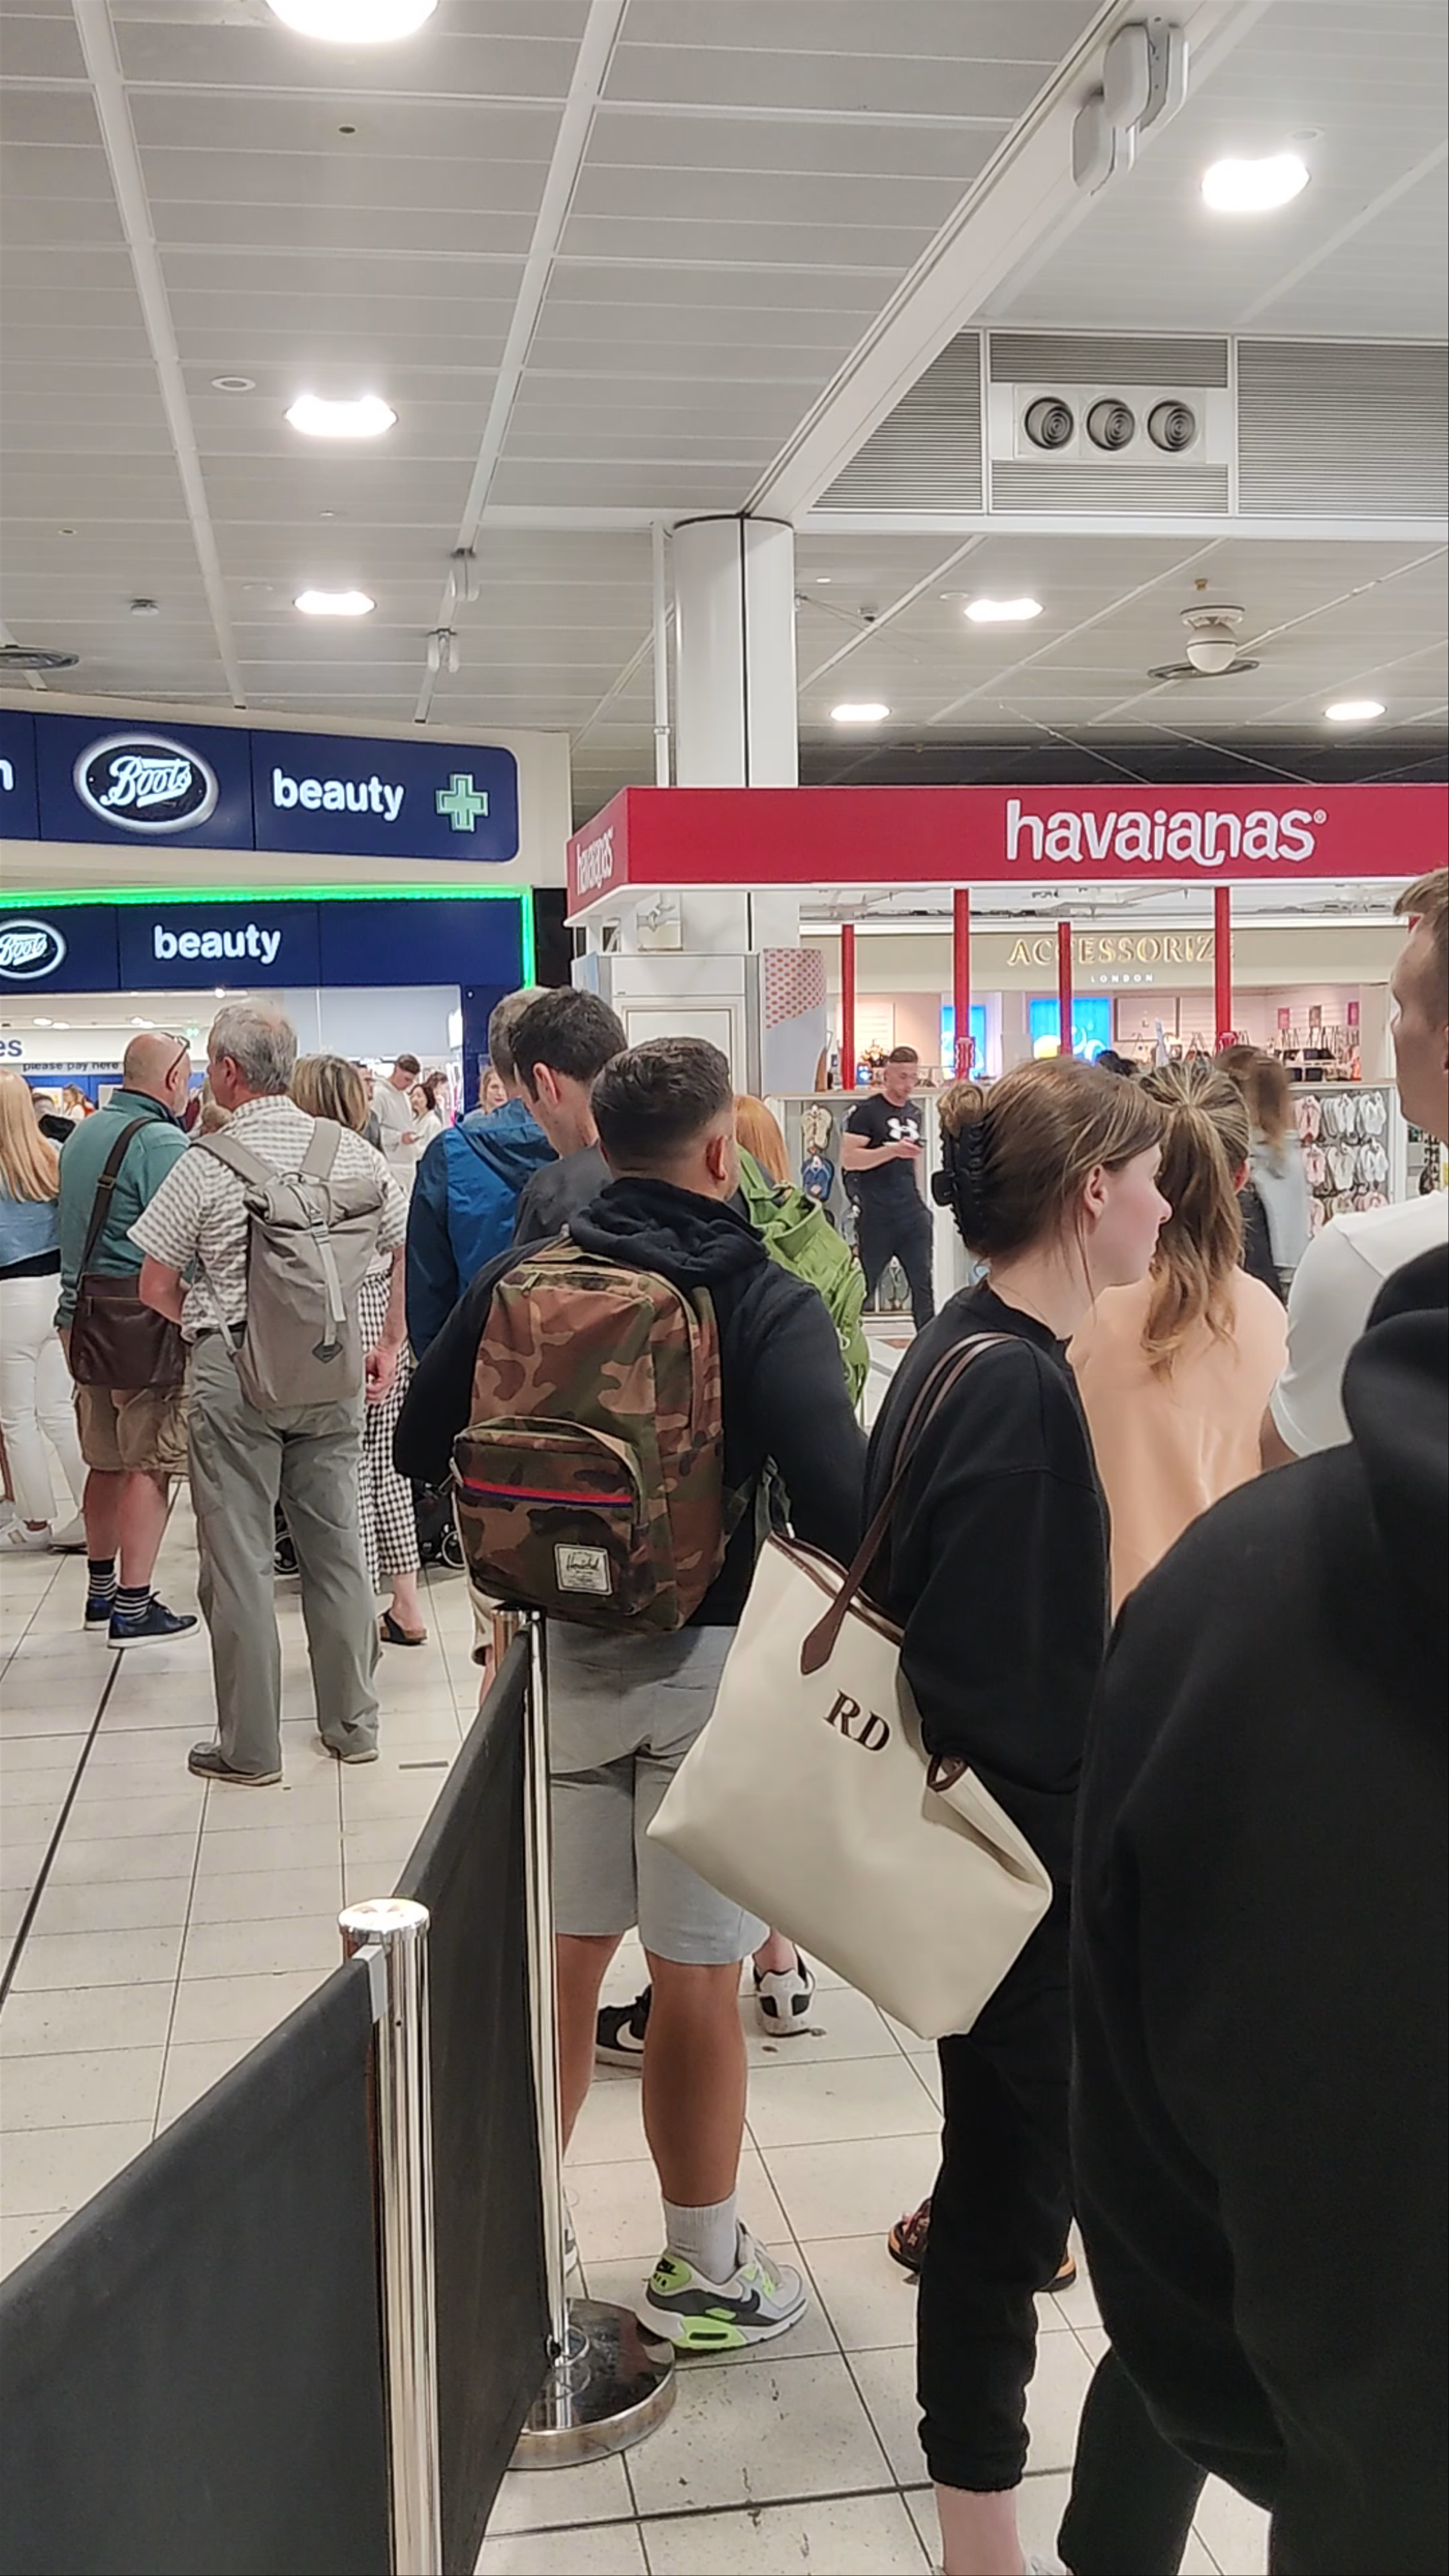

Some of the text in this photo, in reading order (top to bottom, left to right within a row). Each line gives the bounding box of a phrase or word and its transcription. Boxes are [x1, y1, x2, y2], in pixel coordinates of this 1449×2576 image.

[100, 756, 192, 807] Boots
[273, 768, 404, 821] beauty
[155, 924, 281, 964] beauty
[1091, 973, 1153, 983] LONDON
[67, 1062, 89, 1071] pay
[823, 1689, 890, 1751] RD
